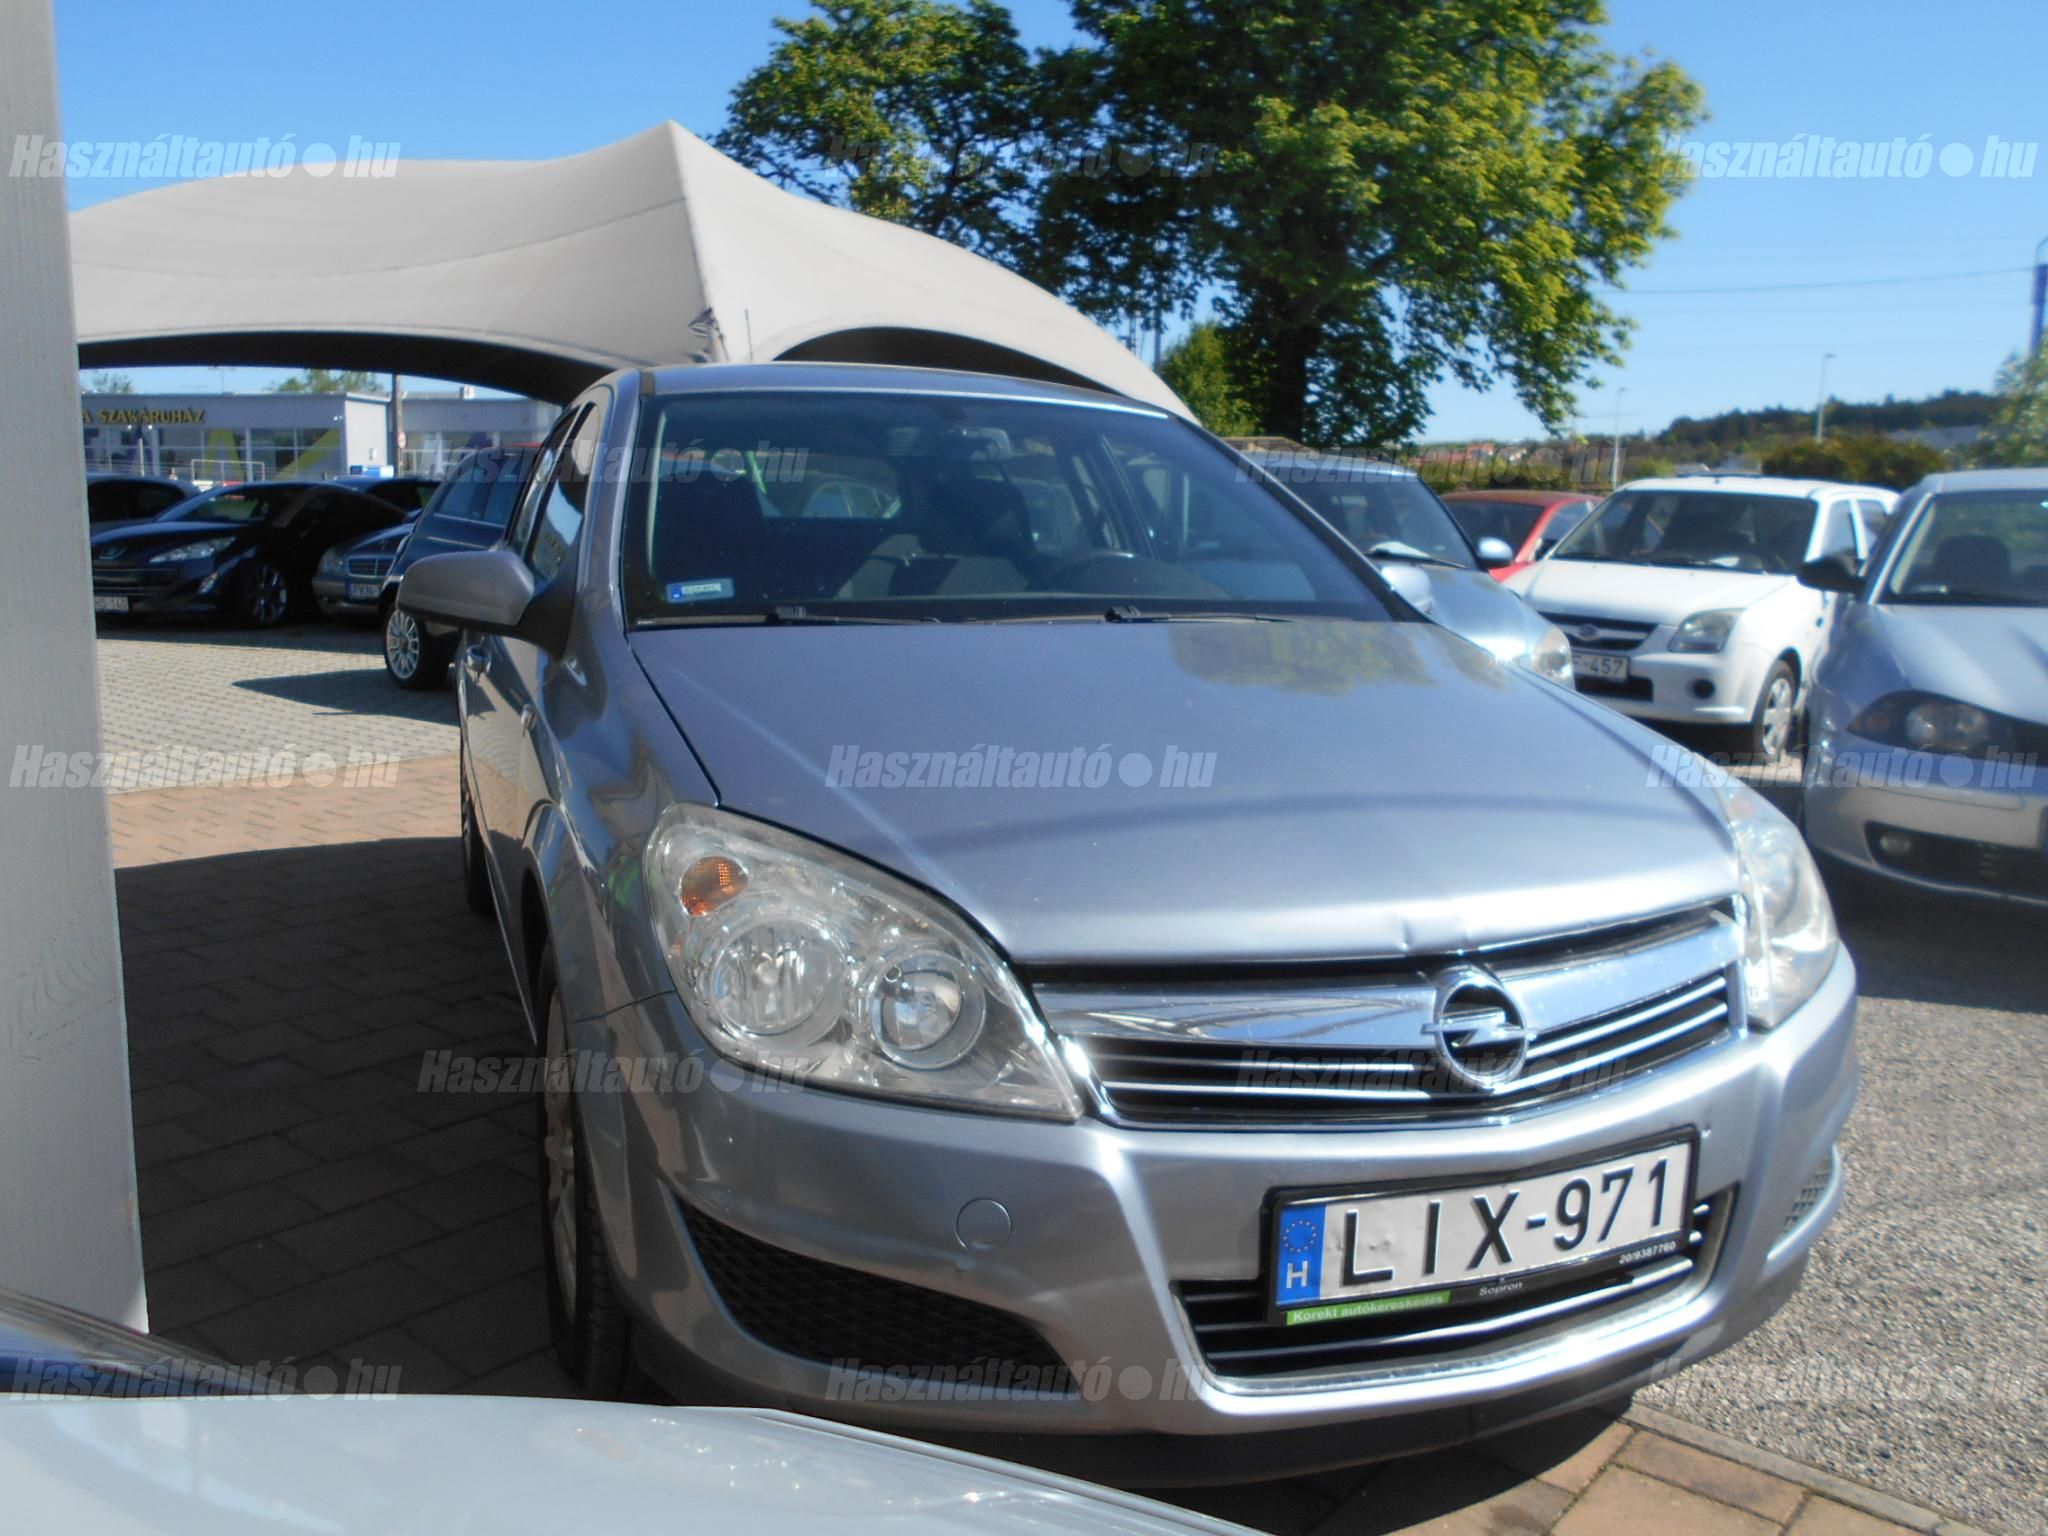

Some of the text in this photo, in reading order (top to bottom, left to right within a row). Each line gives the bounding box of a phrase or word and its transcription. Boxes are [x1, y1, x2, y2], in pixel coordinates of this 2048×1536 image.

[1342, 1158, 1669, 1286] LIX-971
[1479, 1281, 1523, 1297] Sopron
[1293, 1308, 1338, 1323] Korekt
